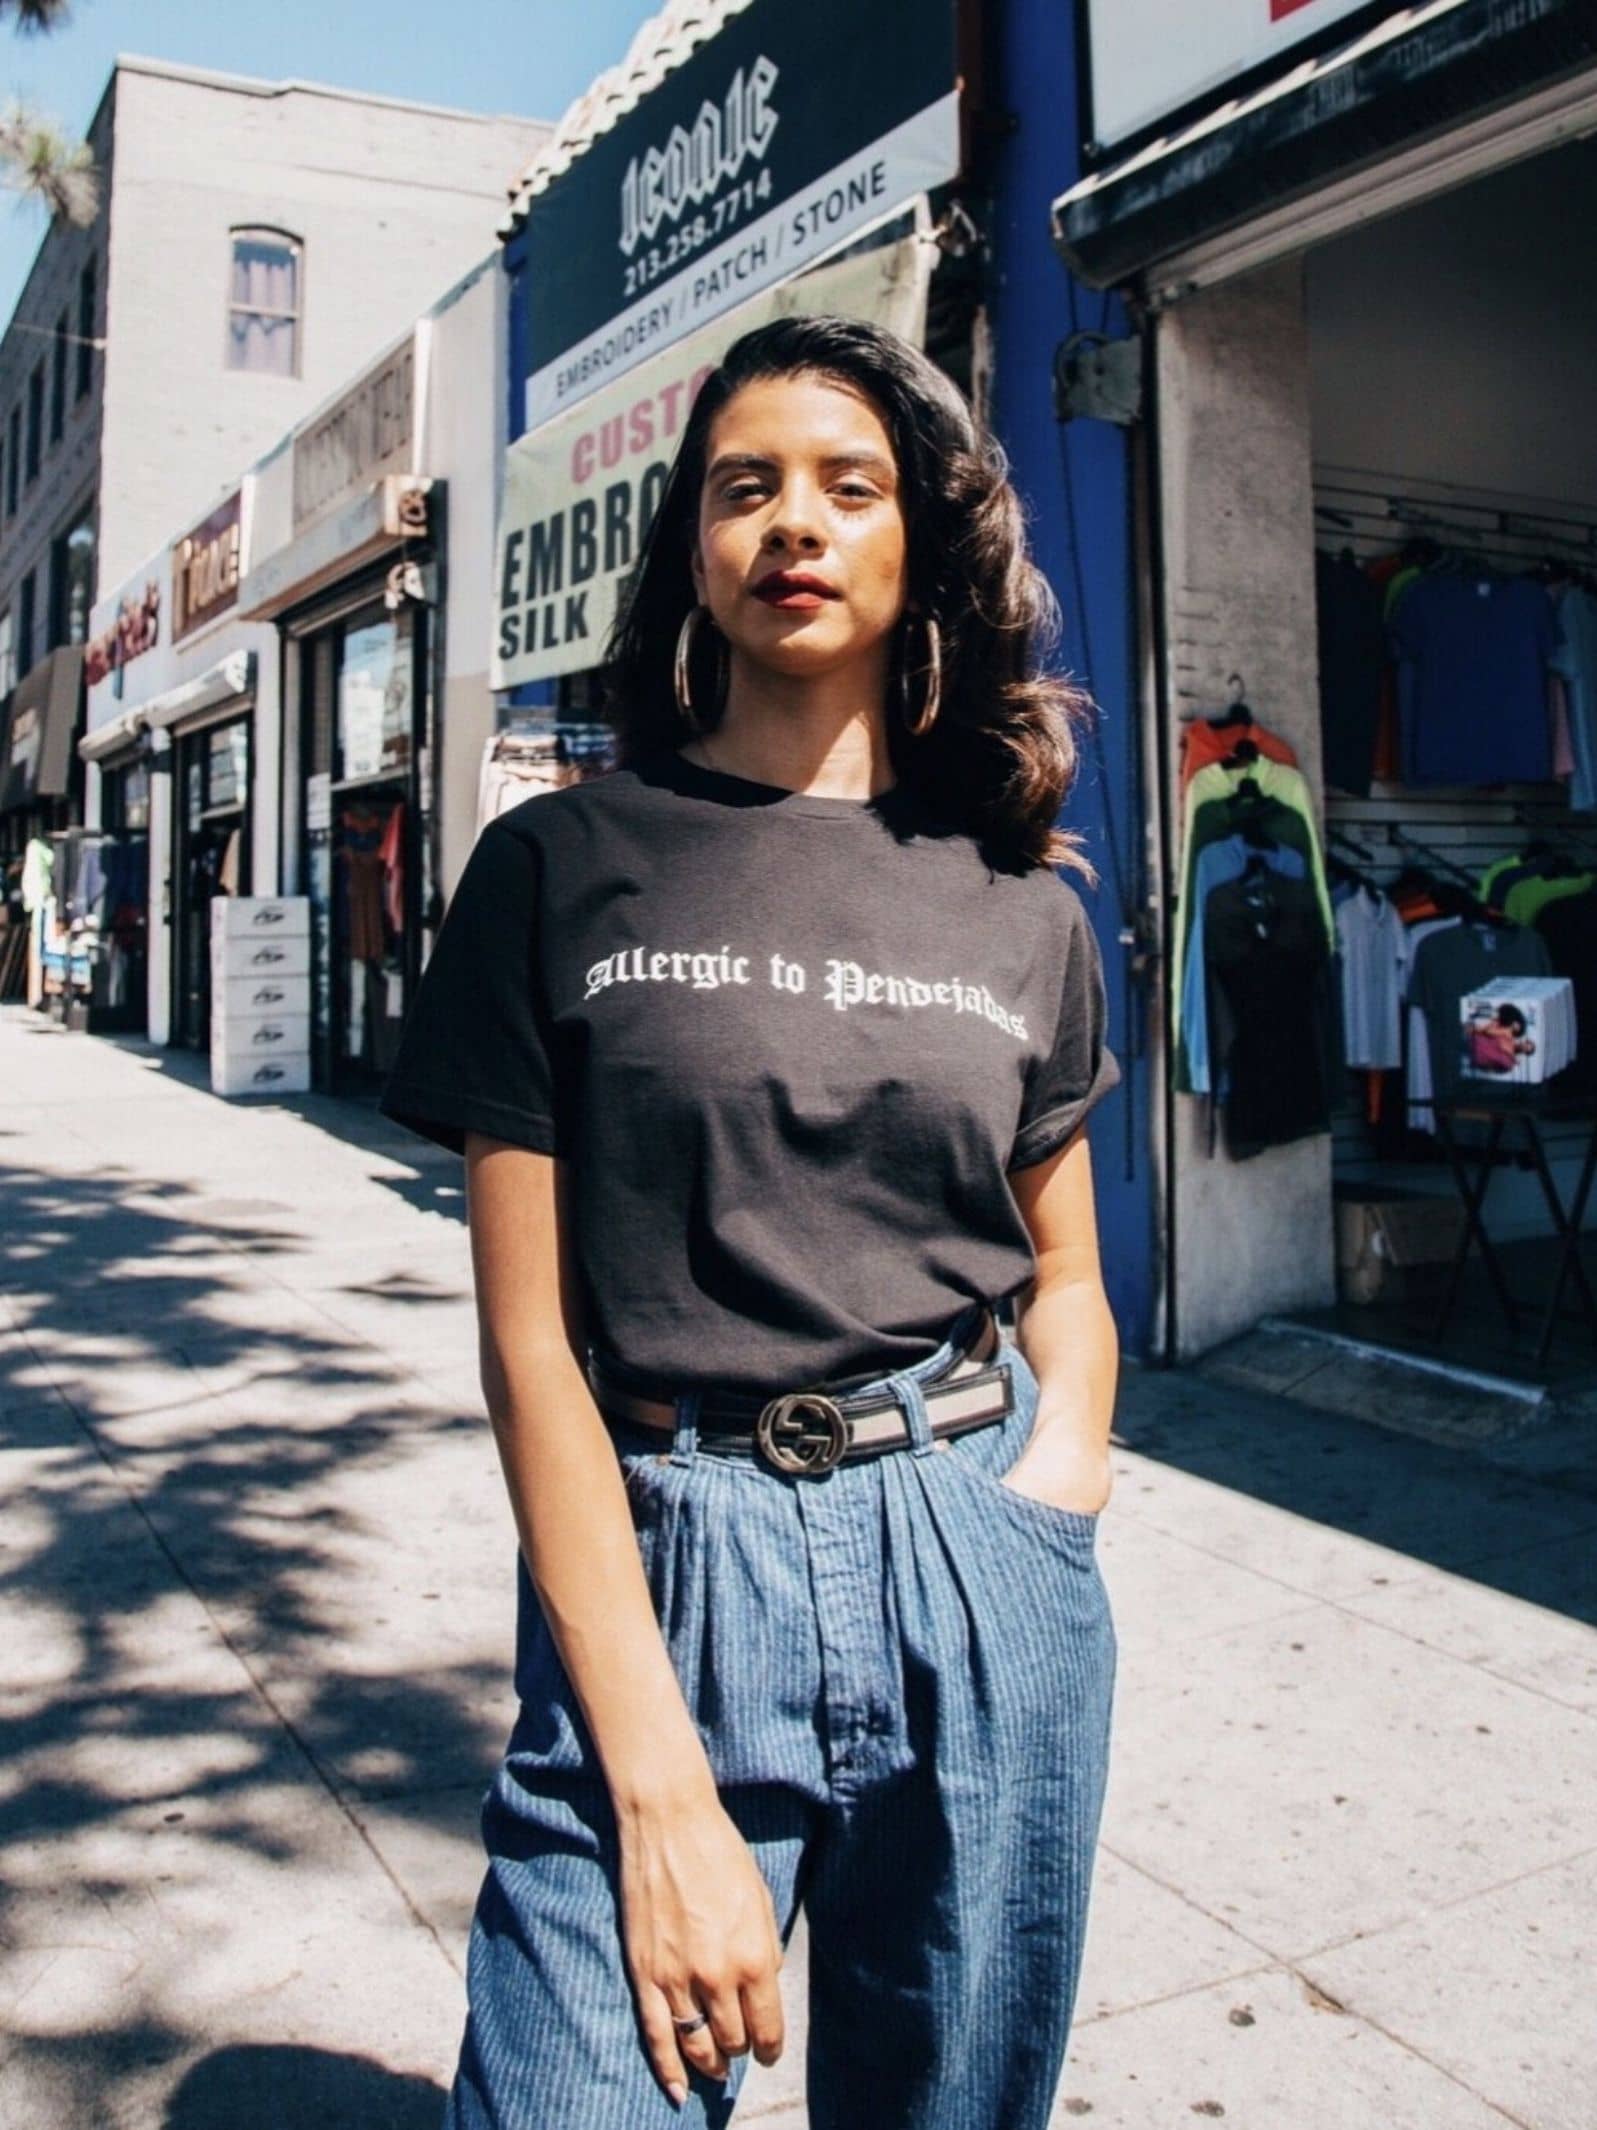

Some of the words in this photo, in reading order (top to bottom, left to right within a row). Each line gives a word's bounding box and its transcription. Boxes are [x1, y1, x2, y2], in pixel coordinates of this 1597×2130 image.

[556, 299, 673, 398] EMBROIDERY
[692, 233, 768, 308] PATCH
[792, 160, 886, 246] STONE
[623, 167, 772, 297] 213.258.7714
[498, 591, 589, 660] SILK
[584, 946, 751, 999] Allergic
[769, 952, 806, 994] to
[823, 959, 1029, 1041] Pendejadas
